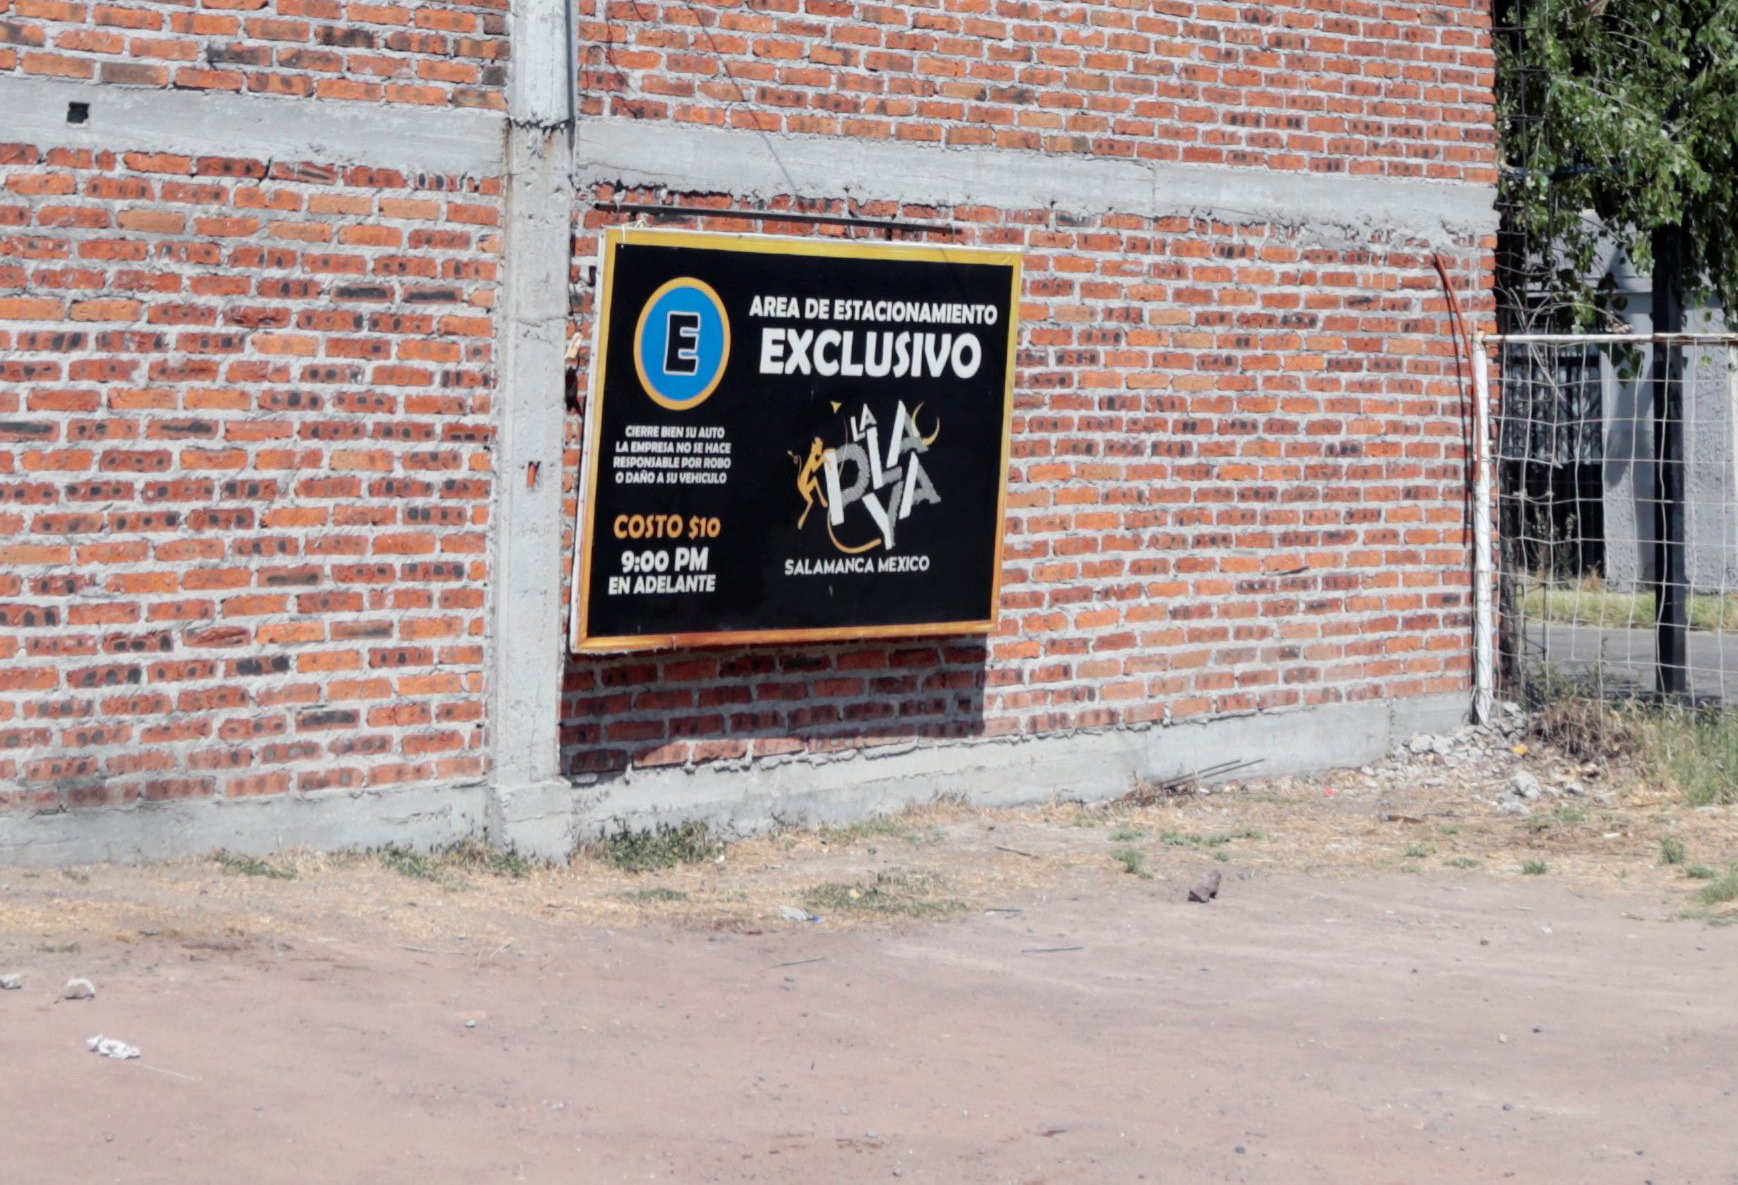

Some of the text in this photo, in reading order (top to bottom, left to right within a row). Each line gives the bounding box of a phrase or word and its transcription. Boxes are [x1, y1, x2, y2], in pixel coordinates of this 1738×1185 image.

[749, 295, 998, 325] AREA DE ESTACIONAMIENTO
[663, 310, 701, 376] E
[759, 327, 982, 379] EXCLUSIVO
[625, 425, 725, 439] CIERRE BIEN SU AUTO
[850, 403, 877, 442] LA
[615, 441, 731, 454] LA EMPRESA NO SE HACE
[613, 456, 731, 469] RESPONSABLE POR ROBO
[615, 469, 727, 484] O DAÑO A SU VEHICULO
[613, 514, 721, 540] COSTO $10
[621, 546, 709, 573] 9:00 PM
[784, 555, 930, 575] SALAMANCA MEXICO
[608, 574, 716, 595] EN ADELANTE
